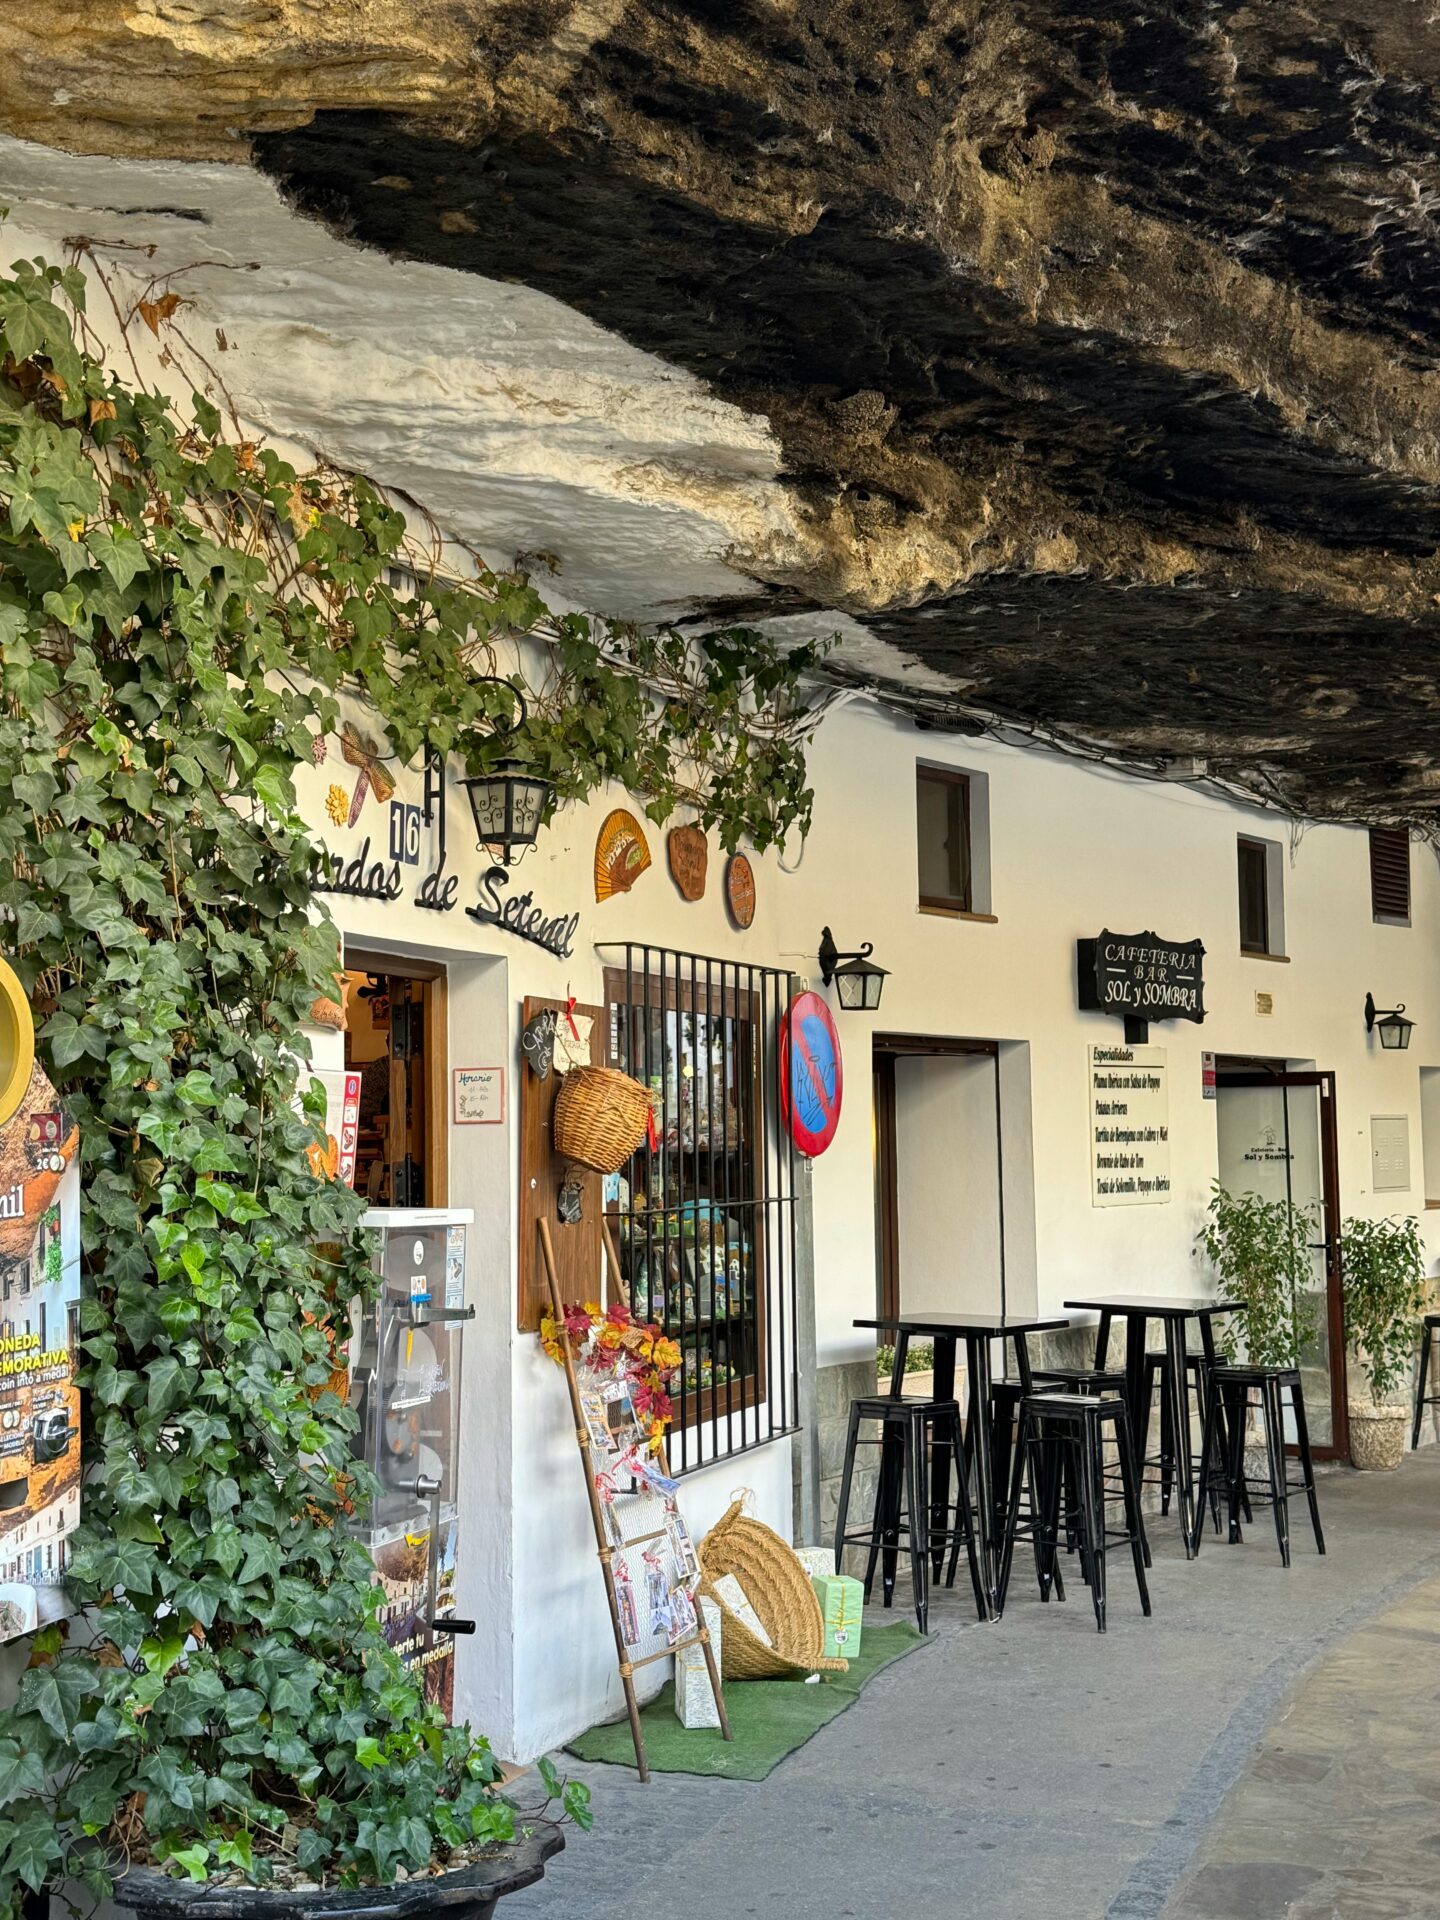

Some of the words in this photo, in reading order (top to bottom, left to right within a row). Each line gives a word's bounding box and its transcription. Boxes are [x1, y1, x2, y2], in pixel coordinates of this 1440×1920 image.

[392, 808, 420, 857] 16
[309, 836, 404, 900] erdos
[416, 851, 459, 911] de
[472, 865, 581, 958] Setenil
[1104, 943, 1196, 970] CAFETERIA
[1133, 964, 1169, 983] BAR
[1104, 980, 1132, 1003] SOL
[1133, 986, 1141, 1008] y
[1142, 982, 1197, 1012] SOMBRA
[1093, 1046, 1134, 1064] Especialidades
[36, 1157, 49, 1169] 2€
[17, 1372, 34, 1387] into
[36, 1374, 41, 1383] a
[43, 1366, 69, 1381] medal
[415, 1632, 425, 1649] tu
[410, 1656, 421, 1671] en
[421, 1639, 454, 1667] medalla
